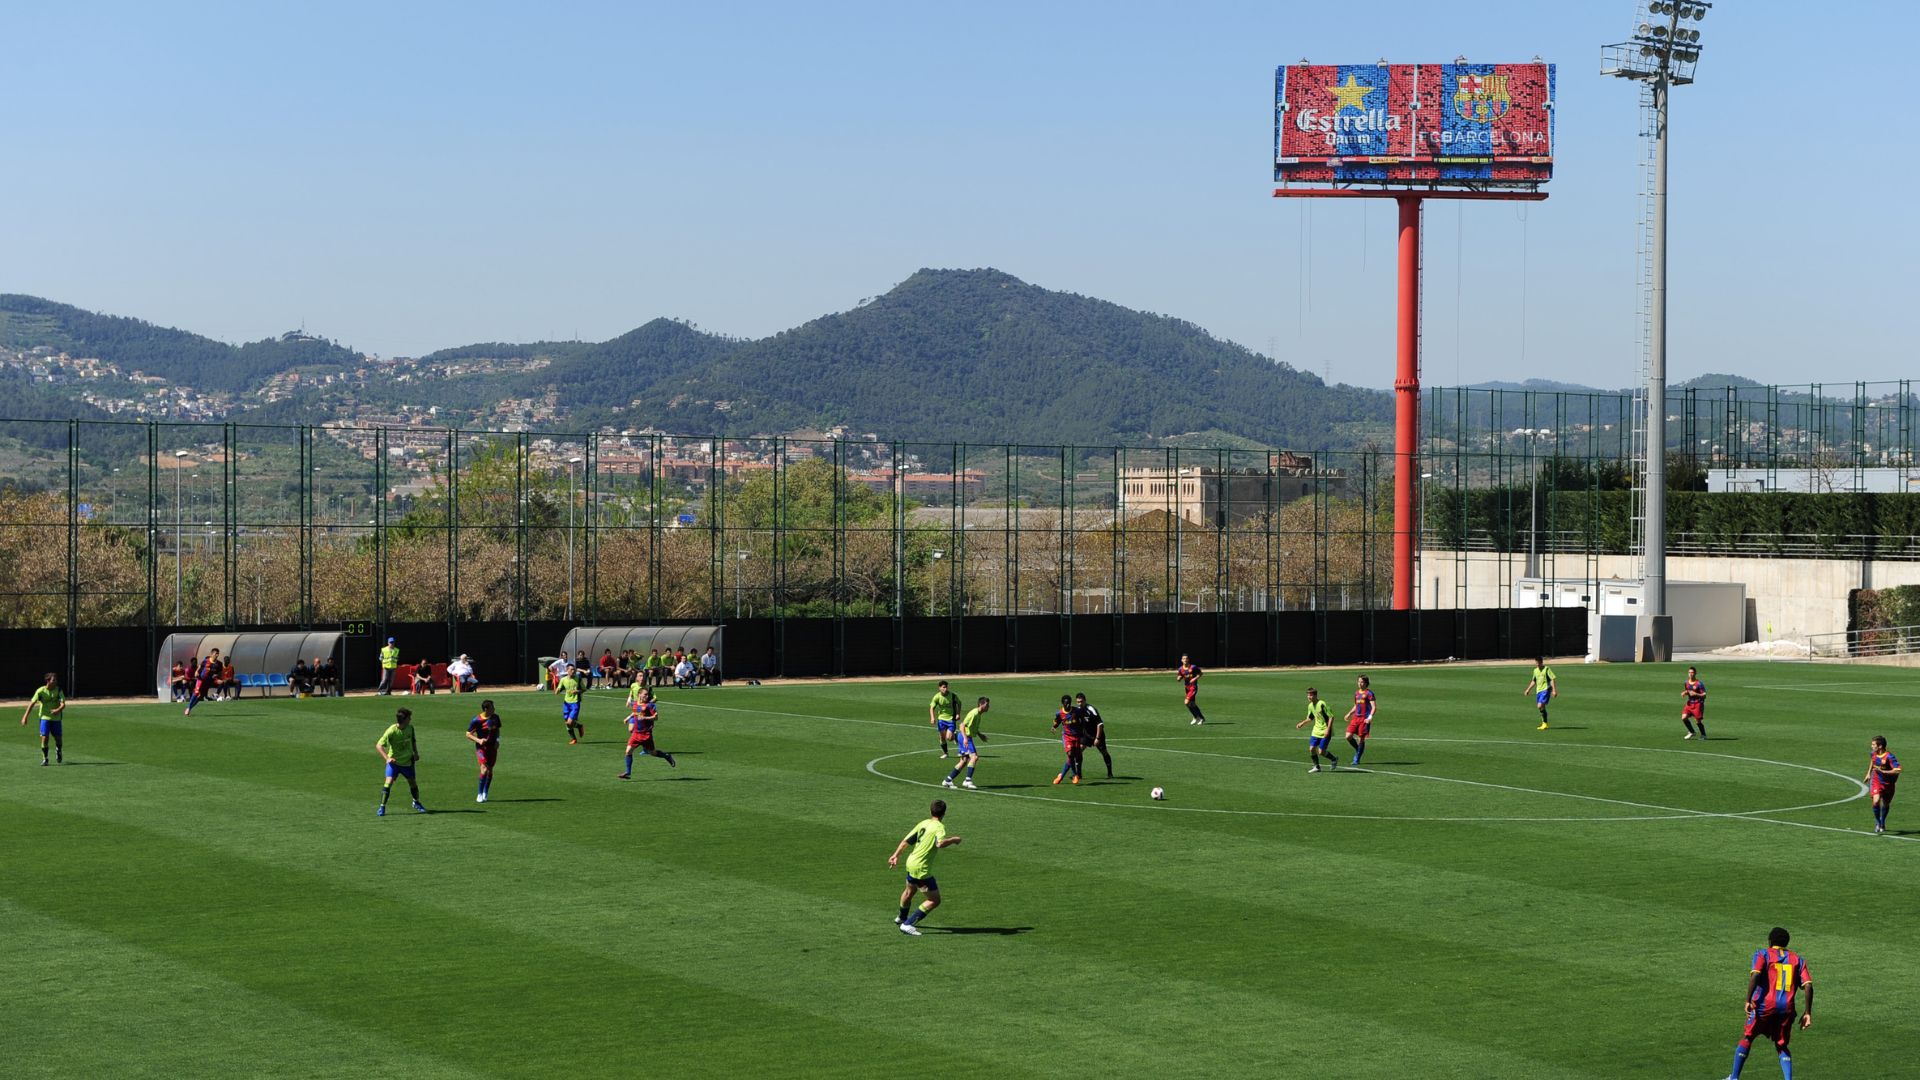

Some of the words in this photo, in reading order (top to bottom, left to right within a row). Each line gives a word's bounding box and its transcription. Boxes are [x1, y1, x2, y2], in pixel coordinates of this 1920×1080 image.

[1296, 108, 1402, 132] Estrella
[1325, 132, 1371, 144] Damm
[1775, 963, 1793, 992] 11
